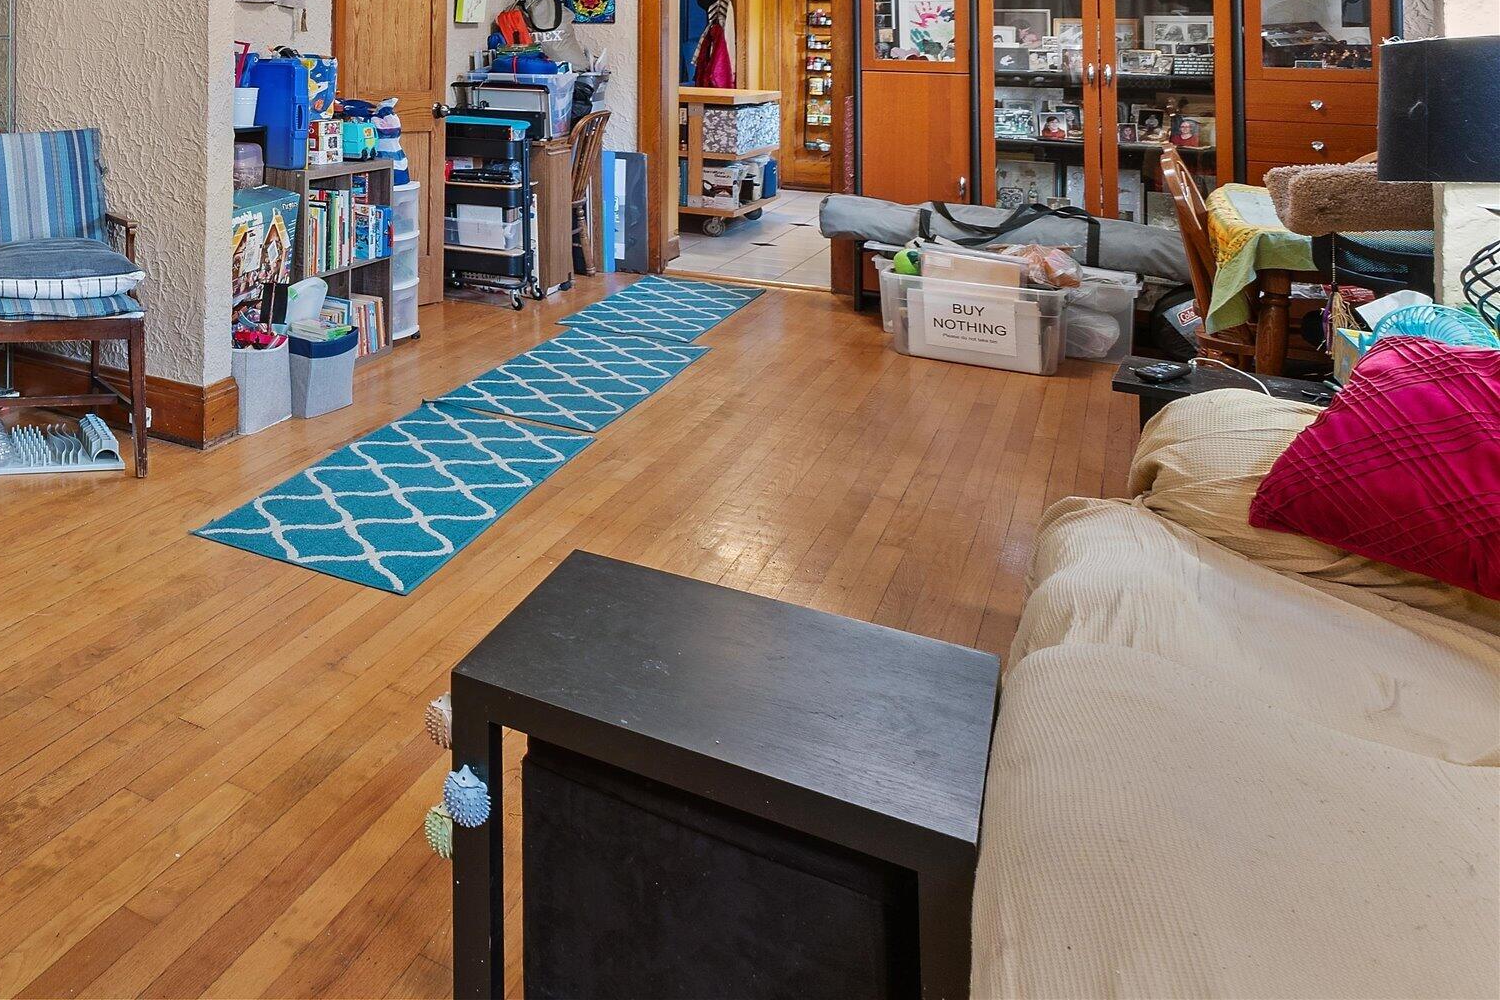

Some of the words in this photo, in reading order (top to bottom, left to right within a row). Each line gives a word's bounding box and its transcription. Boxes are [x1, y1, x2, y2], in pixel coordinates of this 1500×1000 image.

[529, 30, 565, 42] TEX
[953, 304, 985, 317] BUY
[933, 317, 1007, 336] NOTHING
